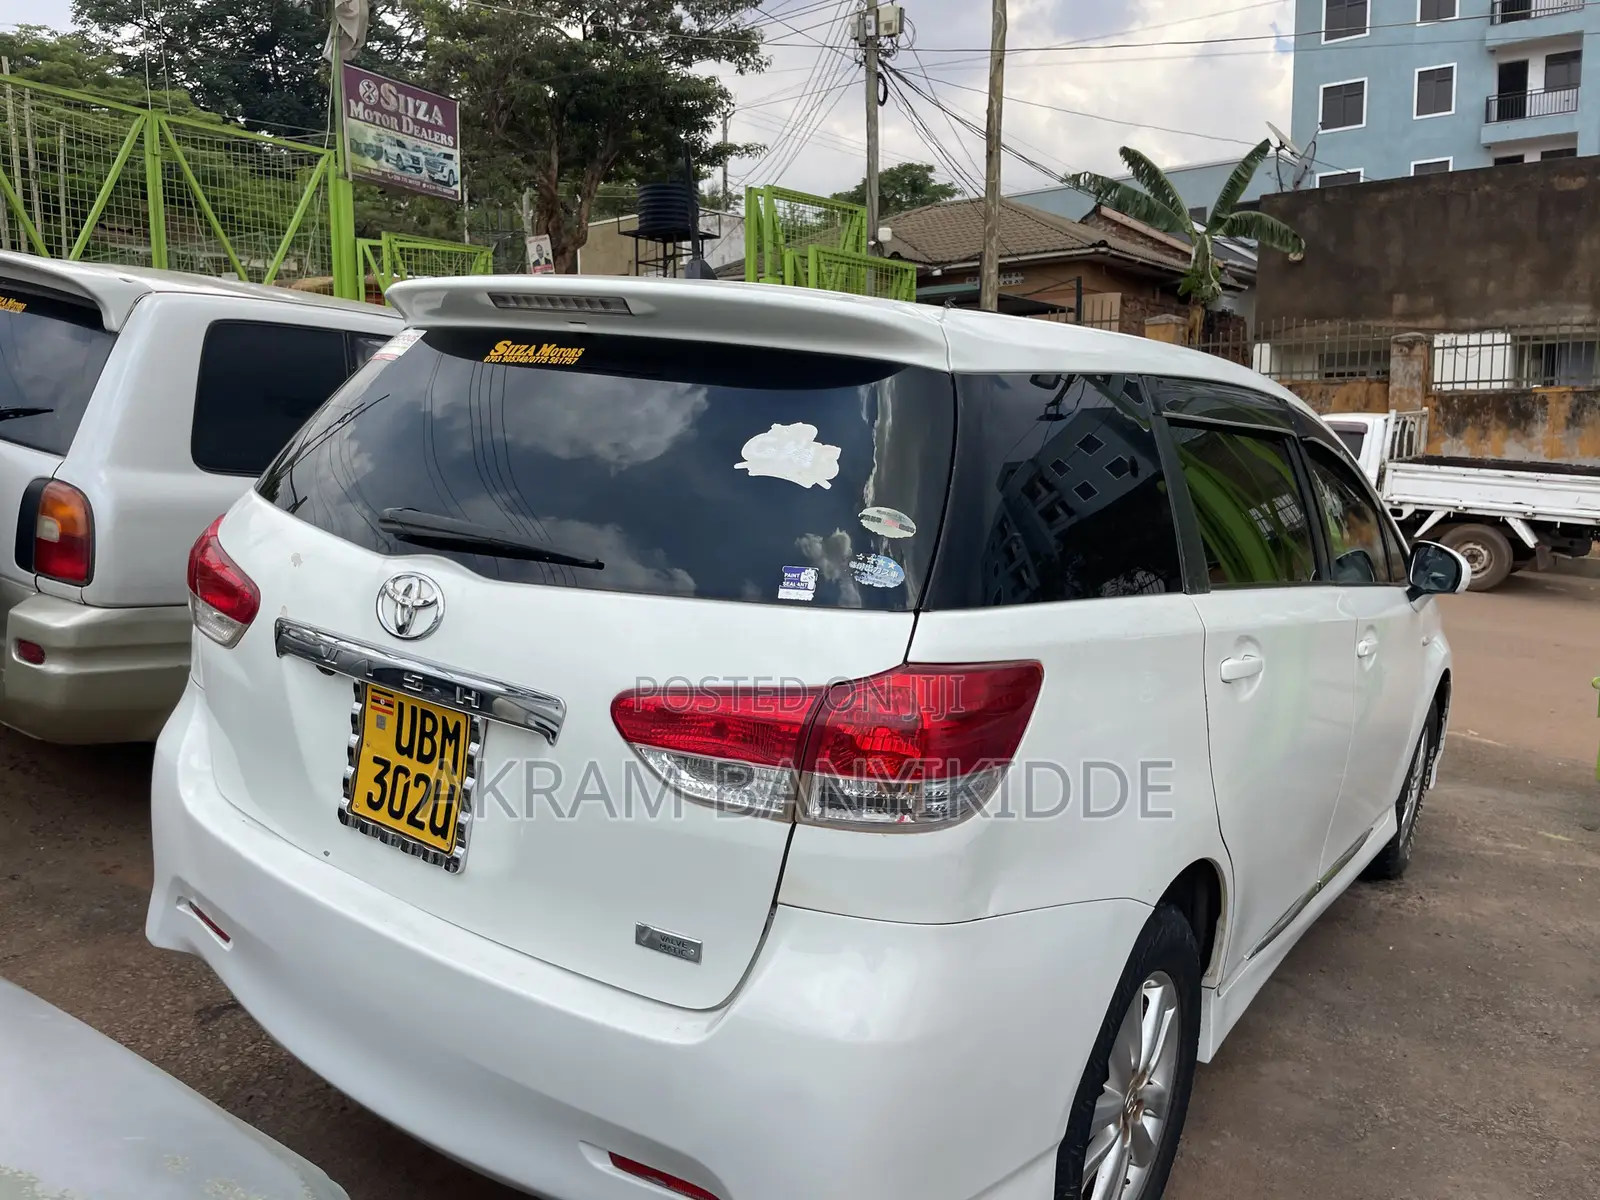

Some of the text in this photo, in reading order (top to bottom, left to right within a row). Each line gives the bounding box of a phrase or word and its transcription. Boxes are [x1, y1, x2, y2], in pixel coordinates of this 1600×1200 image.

[349, 99, 399, 131] MOTOR
[402, 115, 454, 147] DEALERS
[380, 83, 445, 127] SIIZA
[490, 340, 585, 357] SIIZA MOTORS
[395, 701, 461, 776] UBM
[366, 756, 457, 840] 302U
[660, 936, 688, 948] VALVE
[660, 944, 688, 957] MATIC
